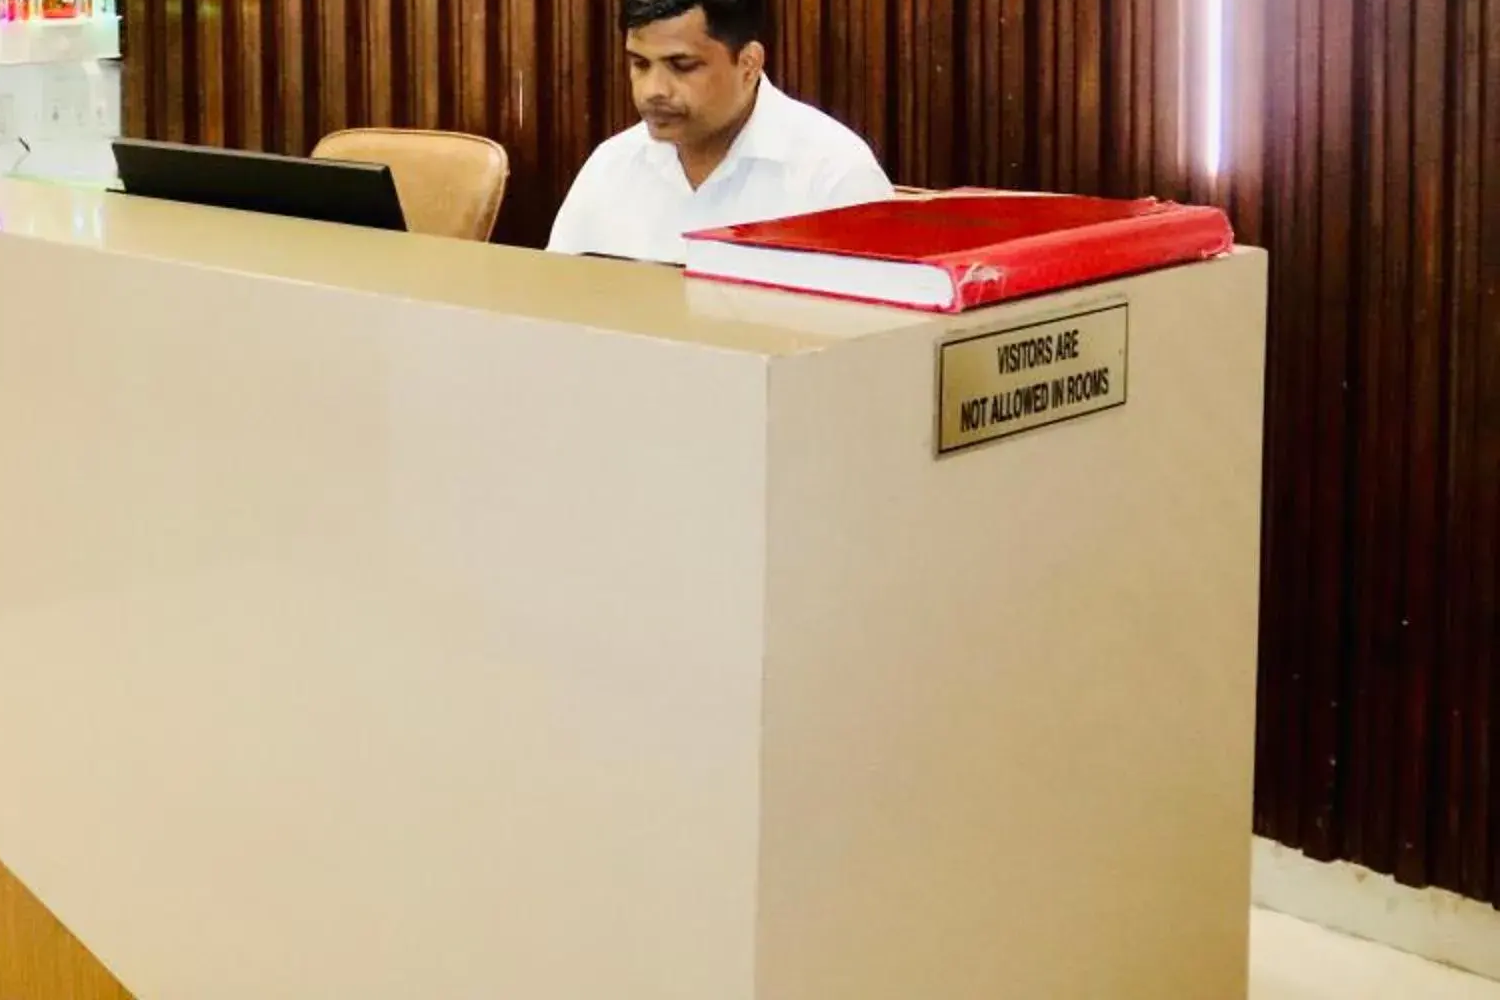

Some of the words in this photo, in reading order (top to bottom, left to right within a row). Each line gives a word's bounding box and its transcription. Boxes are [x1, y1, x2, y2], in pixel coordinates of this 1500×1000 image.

[997, 334, 1054, 375] VISITORS
[1055, 329, 1080, 362] ARE
[960, 396, 989, 433] NOT
[990, 381, 1049, 425] ALLOWED
[1051, 375, 1066, 410] IN
[1067, 366, 1111, 405] ROOMS
